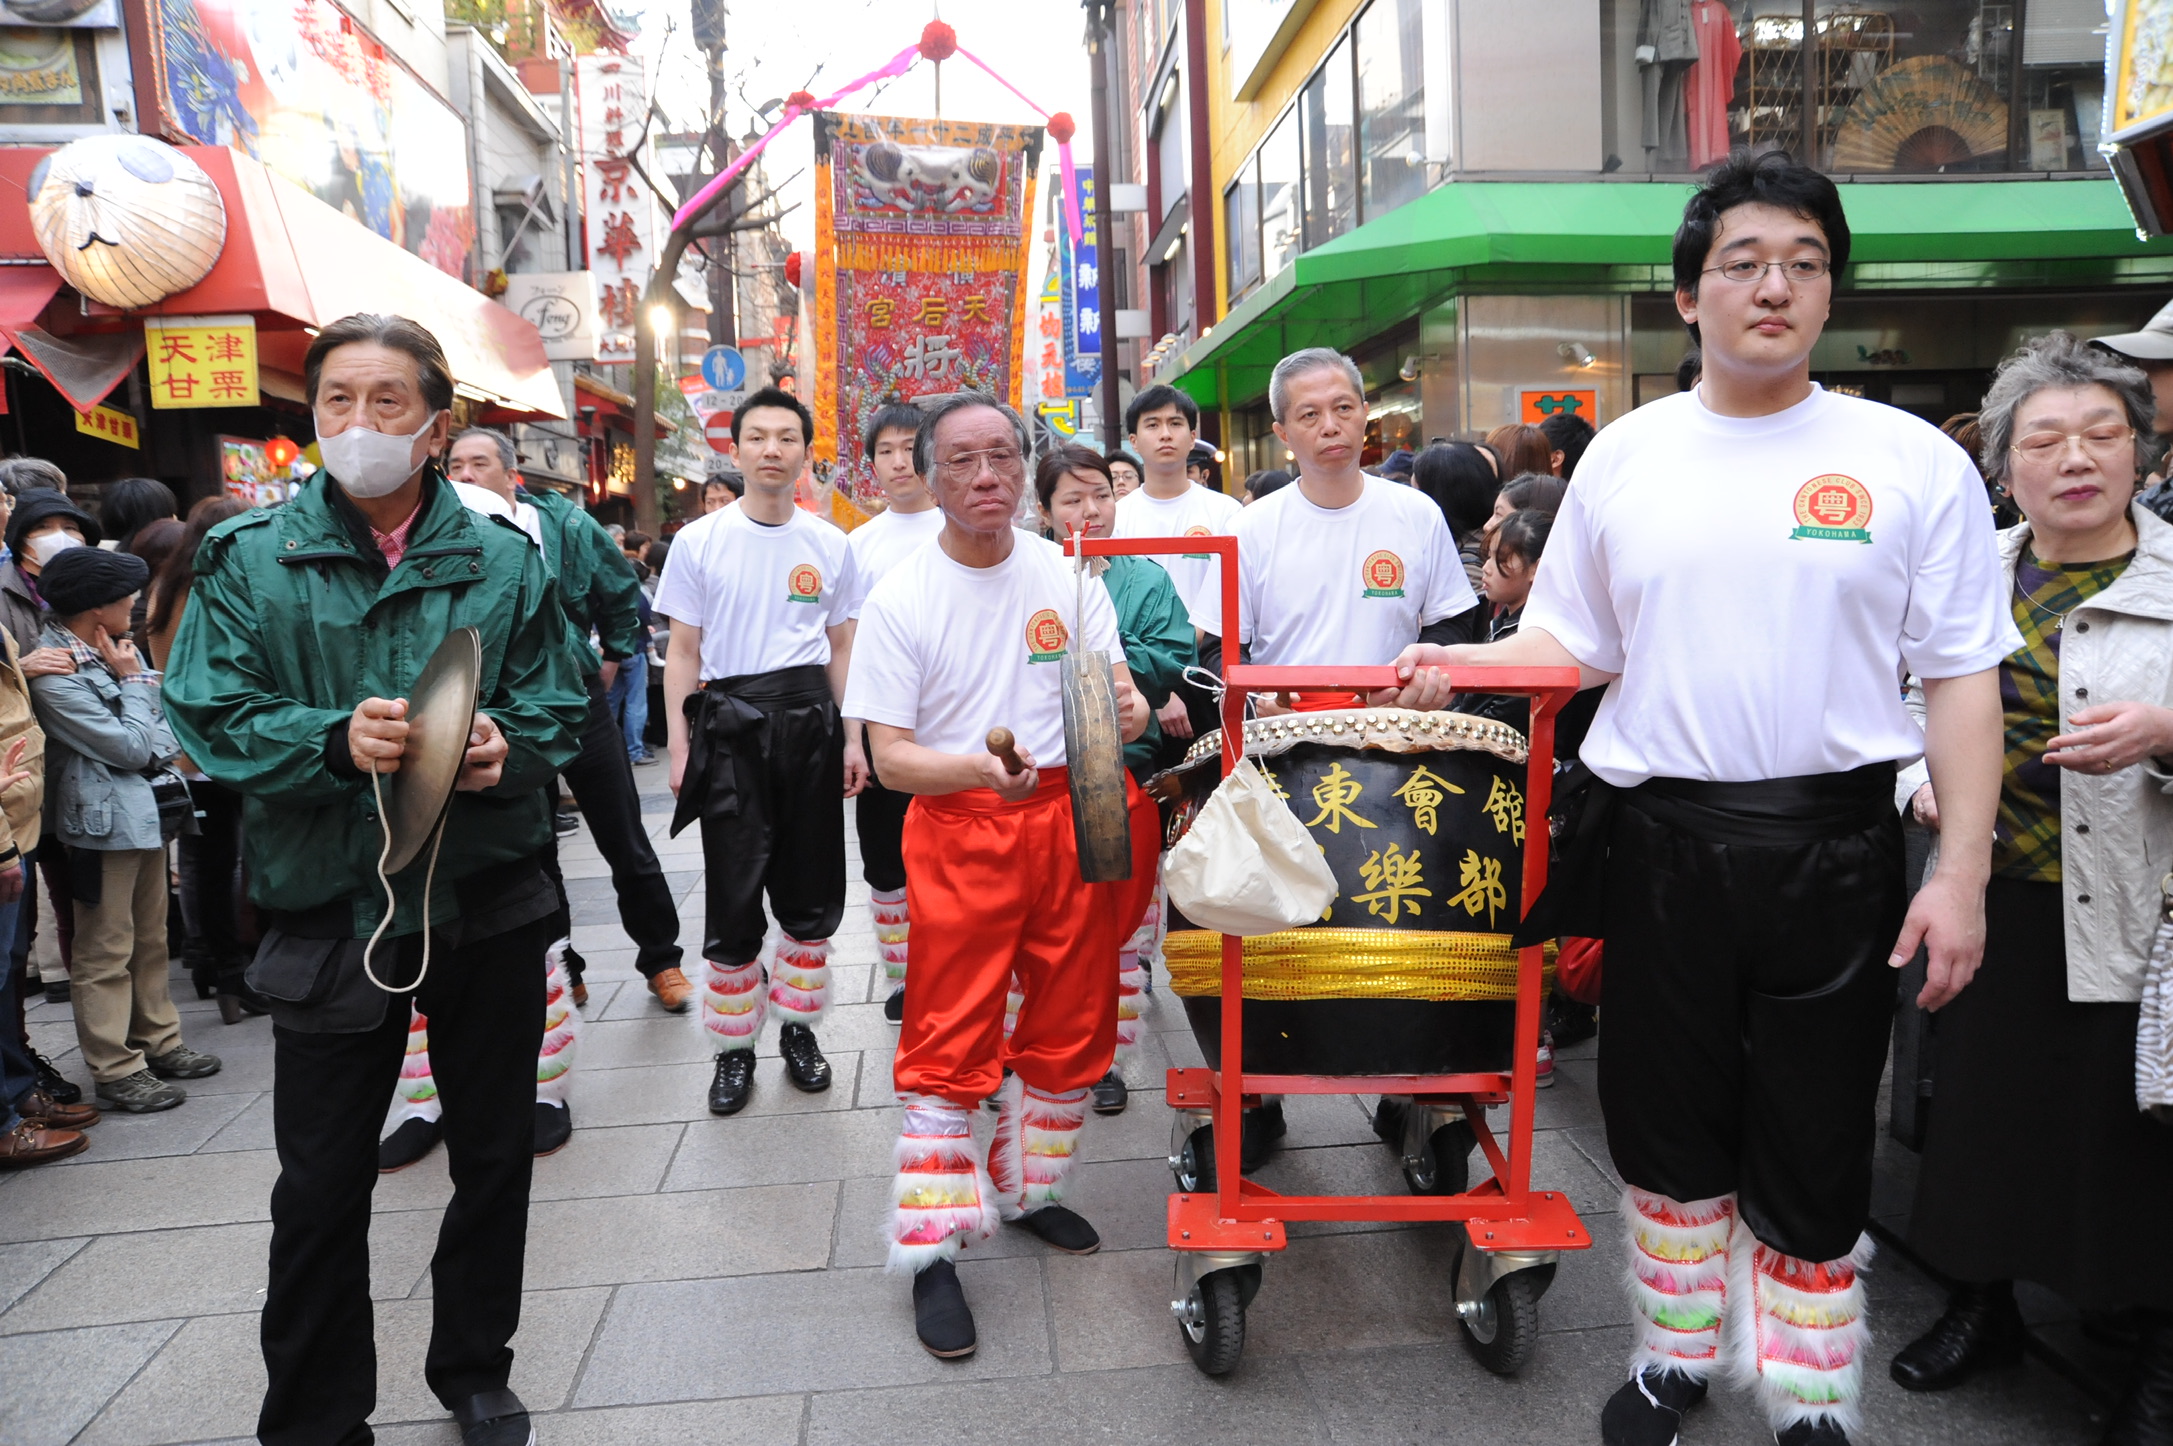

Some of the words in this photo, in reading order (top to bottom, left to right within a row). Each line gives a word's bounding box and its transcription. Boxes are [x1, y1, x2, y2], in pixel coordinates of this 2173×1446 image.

[864, 295, 991, 328] 天后宮
[159, 332, 245, 363] 天津
[162, 370, 248, 400] 甘栗
[82, 411, 133, 440] 天津甘栗
[1798, 477, 1832, 508] CANTONESE
[1835, 477, 1856, 490] CLUB
[1806, 528, 1857, 538] YOKOHAMA
[1317, 842, 1507, 929] 樂部
